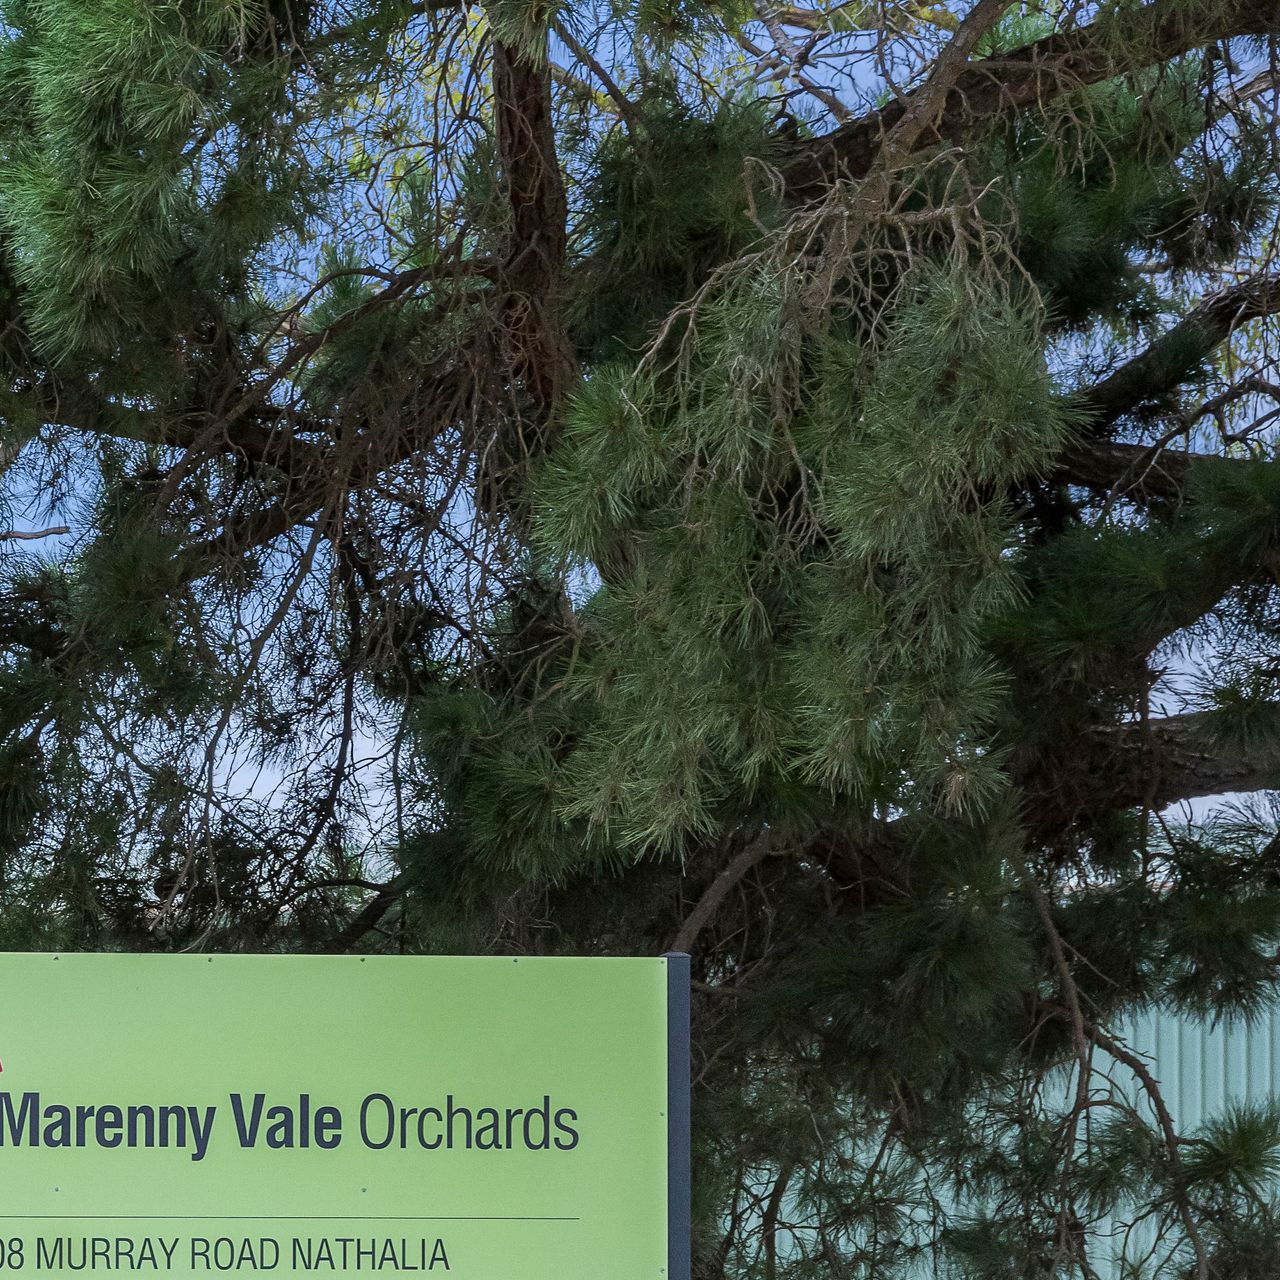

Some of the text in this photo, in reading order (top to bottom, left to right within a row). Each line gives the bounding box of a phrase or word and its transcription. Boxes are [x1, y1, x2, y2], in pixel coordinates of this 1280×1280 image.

[229, 1093, 342, 1150] Vale
[359, 1093, 580, 1151] Orchards
[36, 1237, 180, 1271] MURRAY
[191, 1237, 280, 1271] ROAD
[292, 1238, 450, 1271] NATHALIA
